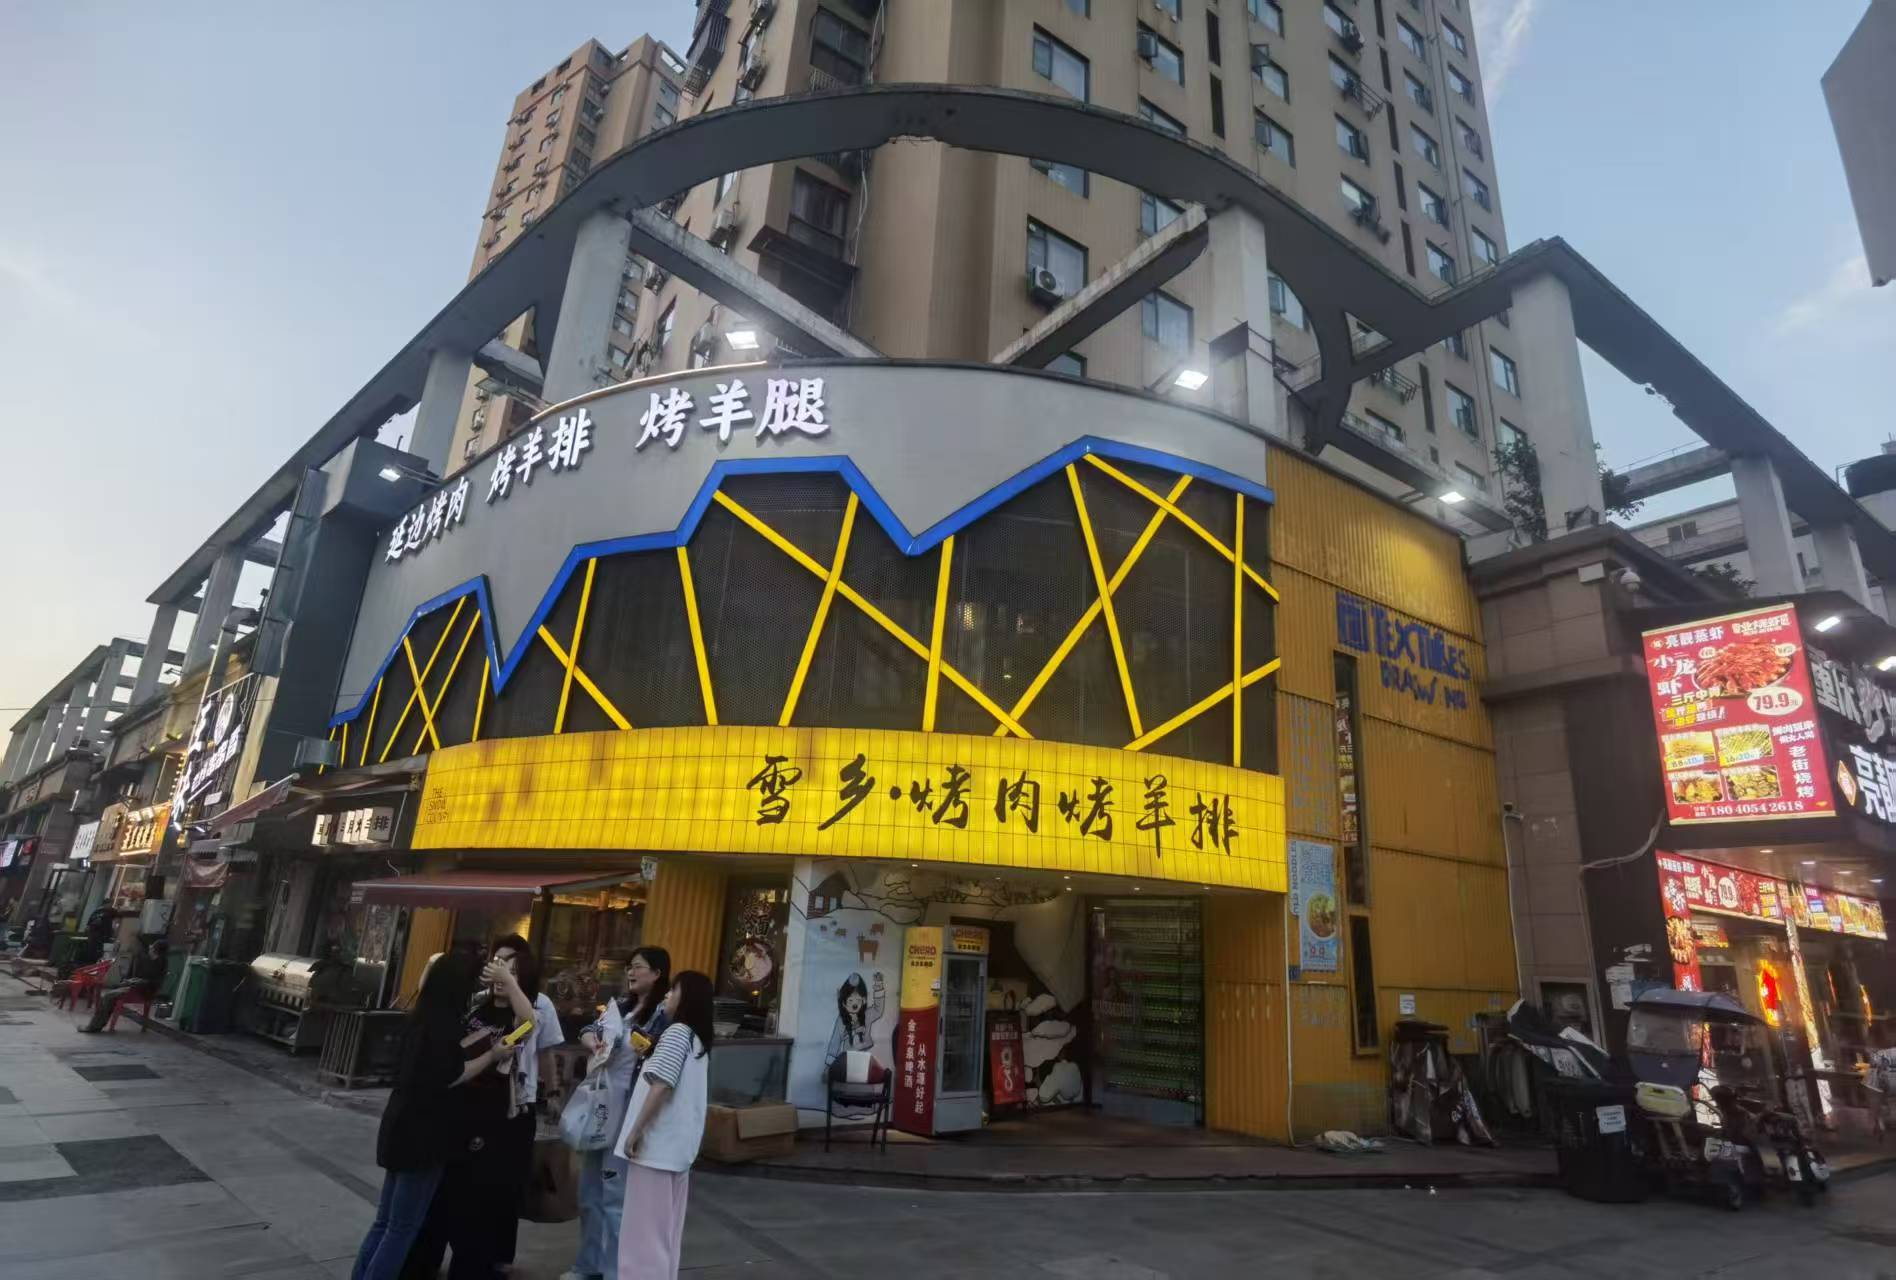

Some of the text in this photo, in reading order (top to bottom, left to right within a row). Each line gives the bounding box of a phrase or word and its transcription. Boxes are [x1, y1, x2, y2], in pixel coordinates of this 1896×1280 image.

[384, 377, 829, 562] 延边烤肉 烤羊排 烤羊腿
